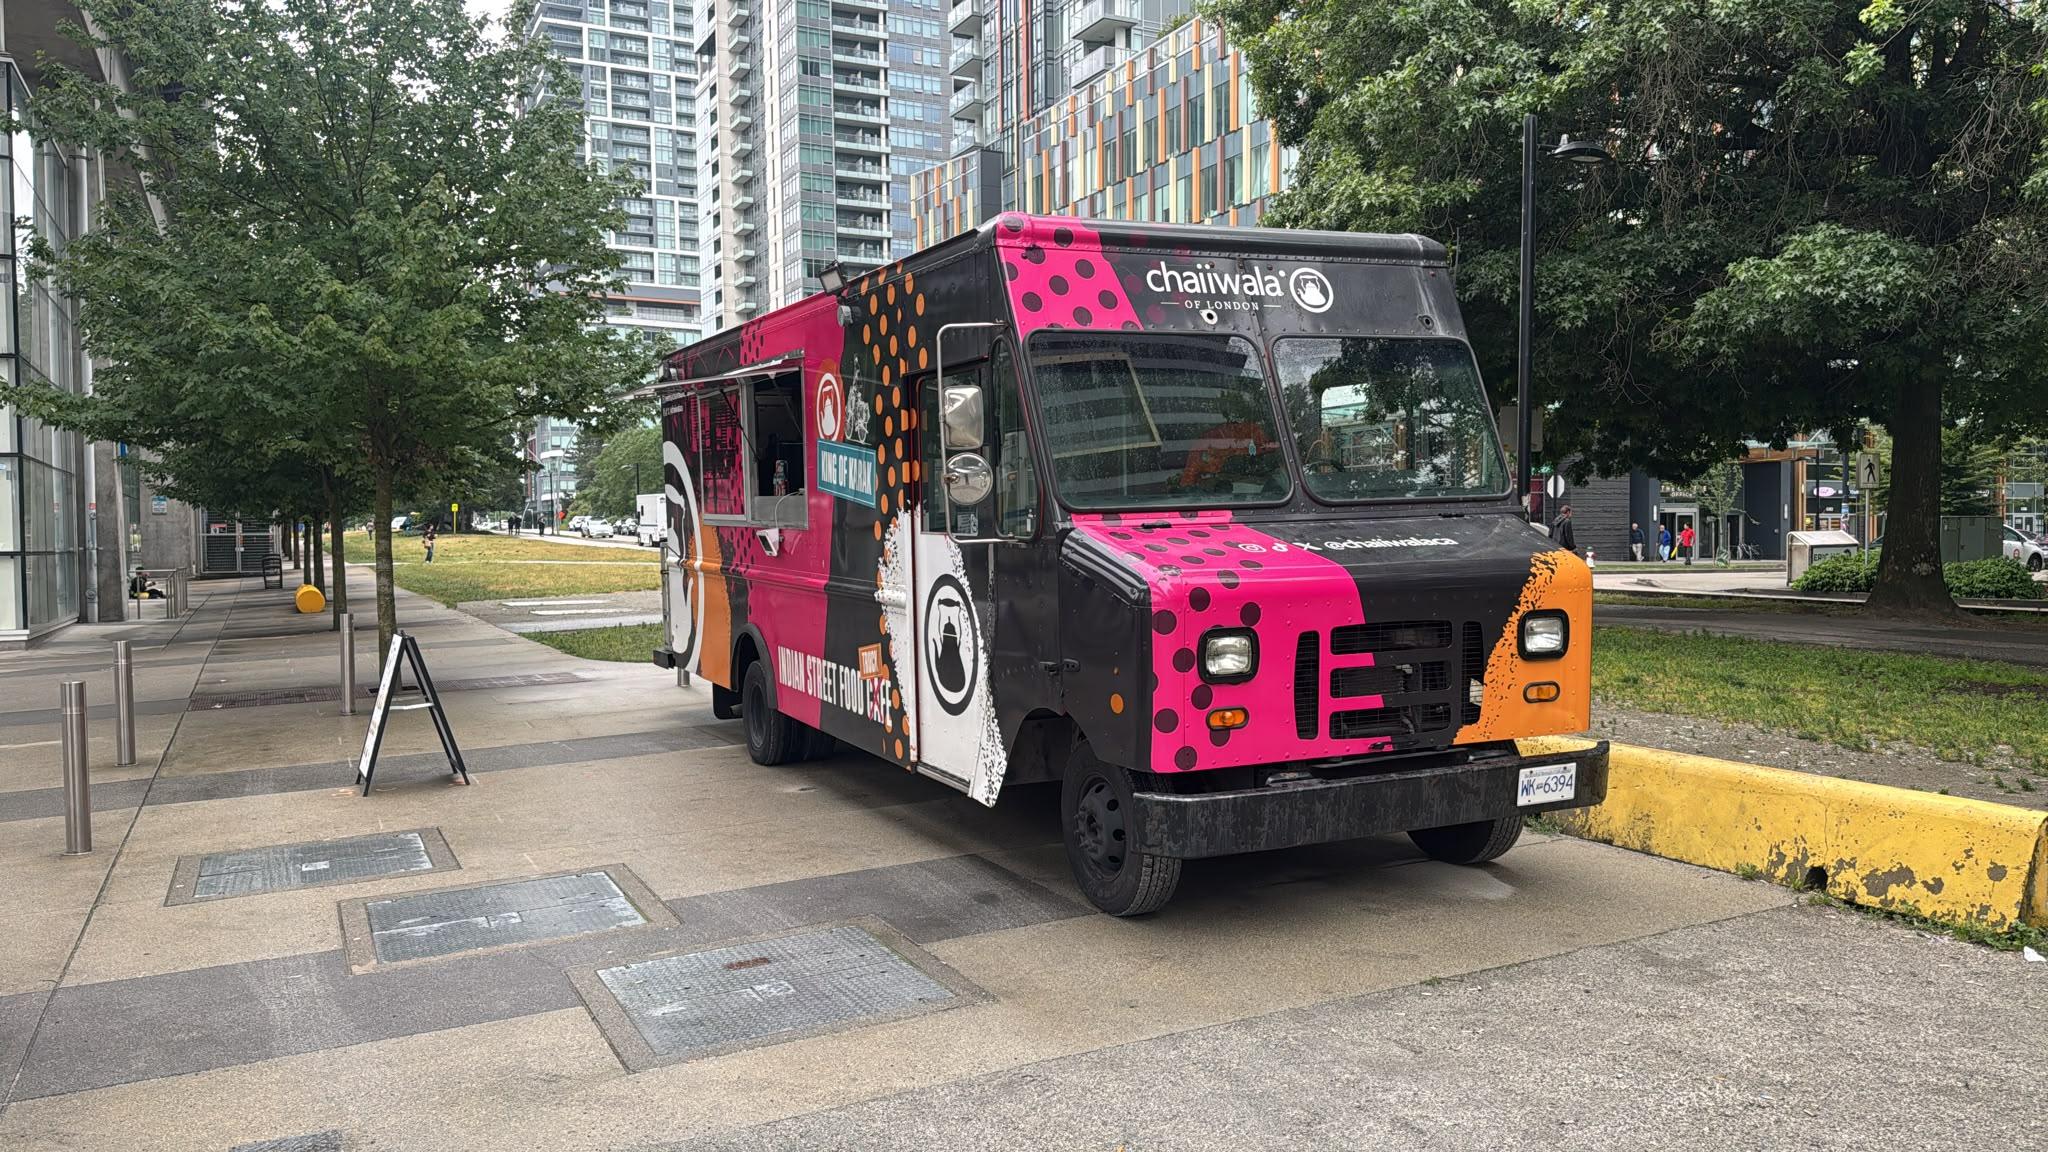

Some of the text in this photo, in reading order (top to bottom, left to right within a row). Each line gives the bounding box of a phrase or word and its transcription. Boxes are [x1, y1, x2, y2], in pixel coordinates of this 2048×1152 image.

[1146, 261, 1284, 296] chaiiwala
[1184, 300, 1259, 311] OF LONDON
[821, 450, 873, 496] KING OF KARAK
[1324, 536, 1459, 550] @chaiiwalaca
[778, 646, 806, 692] INDIAN
[806, 655, 838, 705] STREET
[838, 664, 865, 716] FOOD
[1543, 774, 1574, 794] 6394
